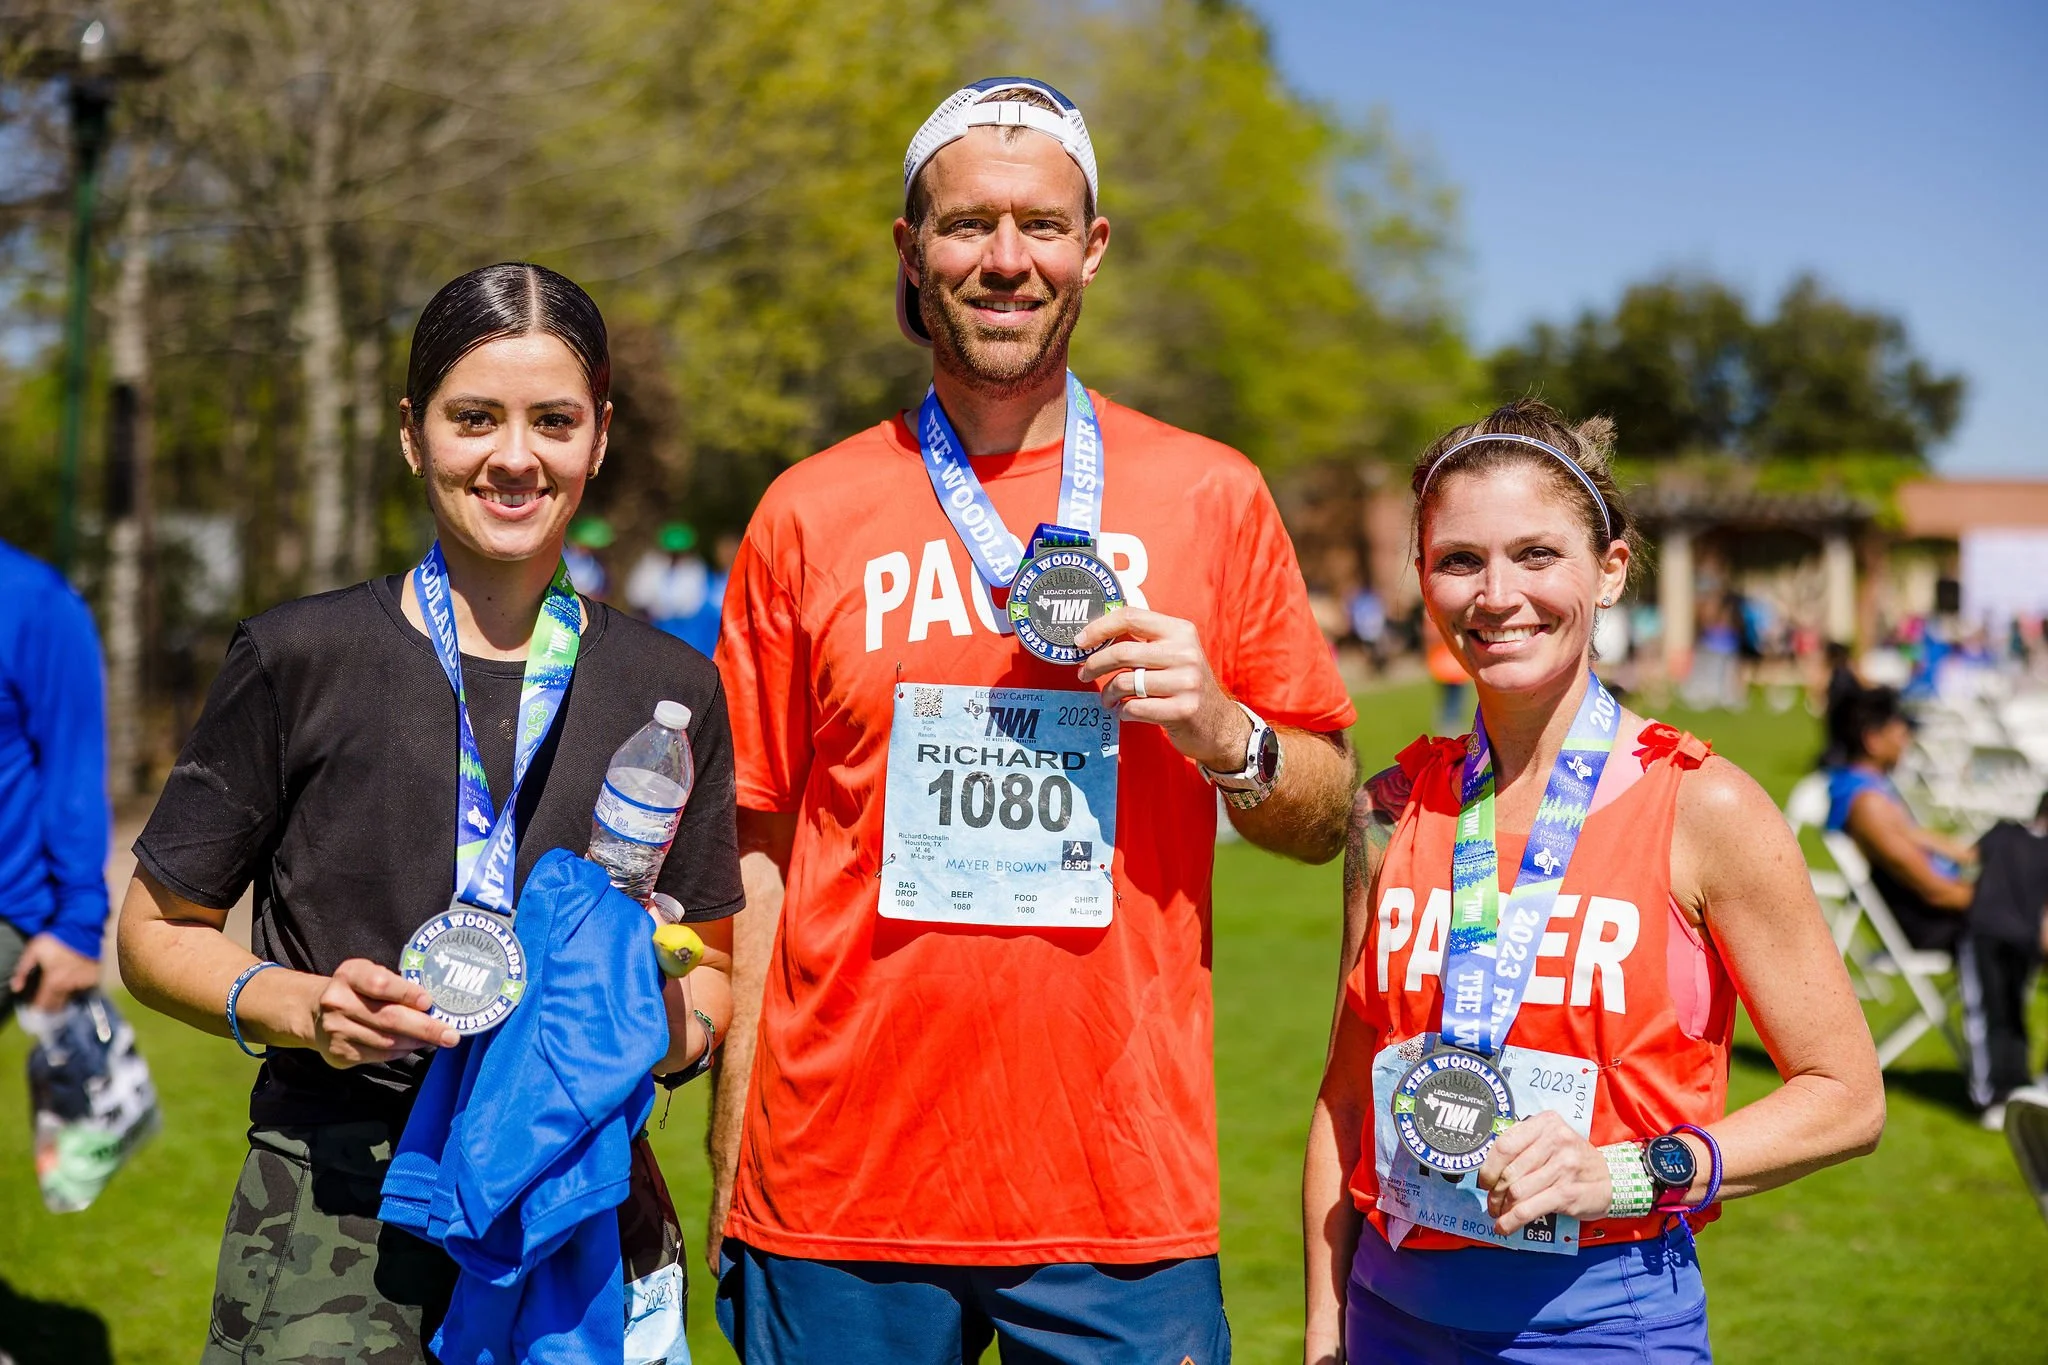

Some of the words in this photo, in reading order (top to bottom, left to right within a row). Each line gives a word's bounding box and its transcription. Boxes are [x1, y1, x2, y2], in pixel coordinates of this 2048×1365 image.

[926, 408, 952, 464] THE
[941, 458, 1016, 584] WOODLA
[1016, 570, 1038, 597] THE
[1037, 554, 1116, 596] WOODLANDS
[864, 532, 1151, 653] PAR
[1020, 624, 1048, 653] 2023
[975, 690, 1007, 699] LEGACY
[1010, 692, 1044, 701] CAPITAL
[1590, 678, 1616, 733] 202
[984, 706, 1040, 739] TWM
[1058, 706, 1100, 727] 2023
[1101, 714, 1112, 752] 1080
[918, 744, 1086, 770] RICHARD
[928, 769, 1072, 832] 1080
[911, 853, 935, 861] M-Large
[1064, 860, 1088, 870] 6:50
[1071, 842, 1084, 856] A
[946, 859, 989, 870] MAYER
[996, 861, 1047, 872] BROWN
[1070, 908, 1102, 916] M-Large
[416, 920, 446, 948] THE
[448, 912, 522, 974] WOODLANDS
[1378, 887, 1640, 1014] PAER
[1496, 907, 1540, 979] 2023
[1455, 970, 1484, 1014] THE
[1406, 1063, 1432, 1090] THE
[1434, 1056, 1510, 1112] WOODLANDS
[1434, 1088, 1458, 1100] LEGACY
[1458, 1094, 1484, 1106] CAPITAL
[1530, 1068, 1574, 1094] 2023
[1573, 1083, 1586, 1120] 1074
[1400, 1120, 1426, 1154] 2023
[1419, 1209, 1456, 1227] MAYER
[1462, 1221, 1508, 1241] BROW
[1527, 1230, 1552, 1242] 6:50
[644, 1282, 672, 1312] 2023
